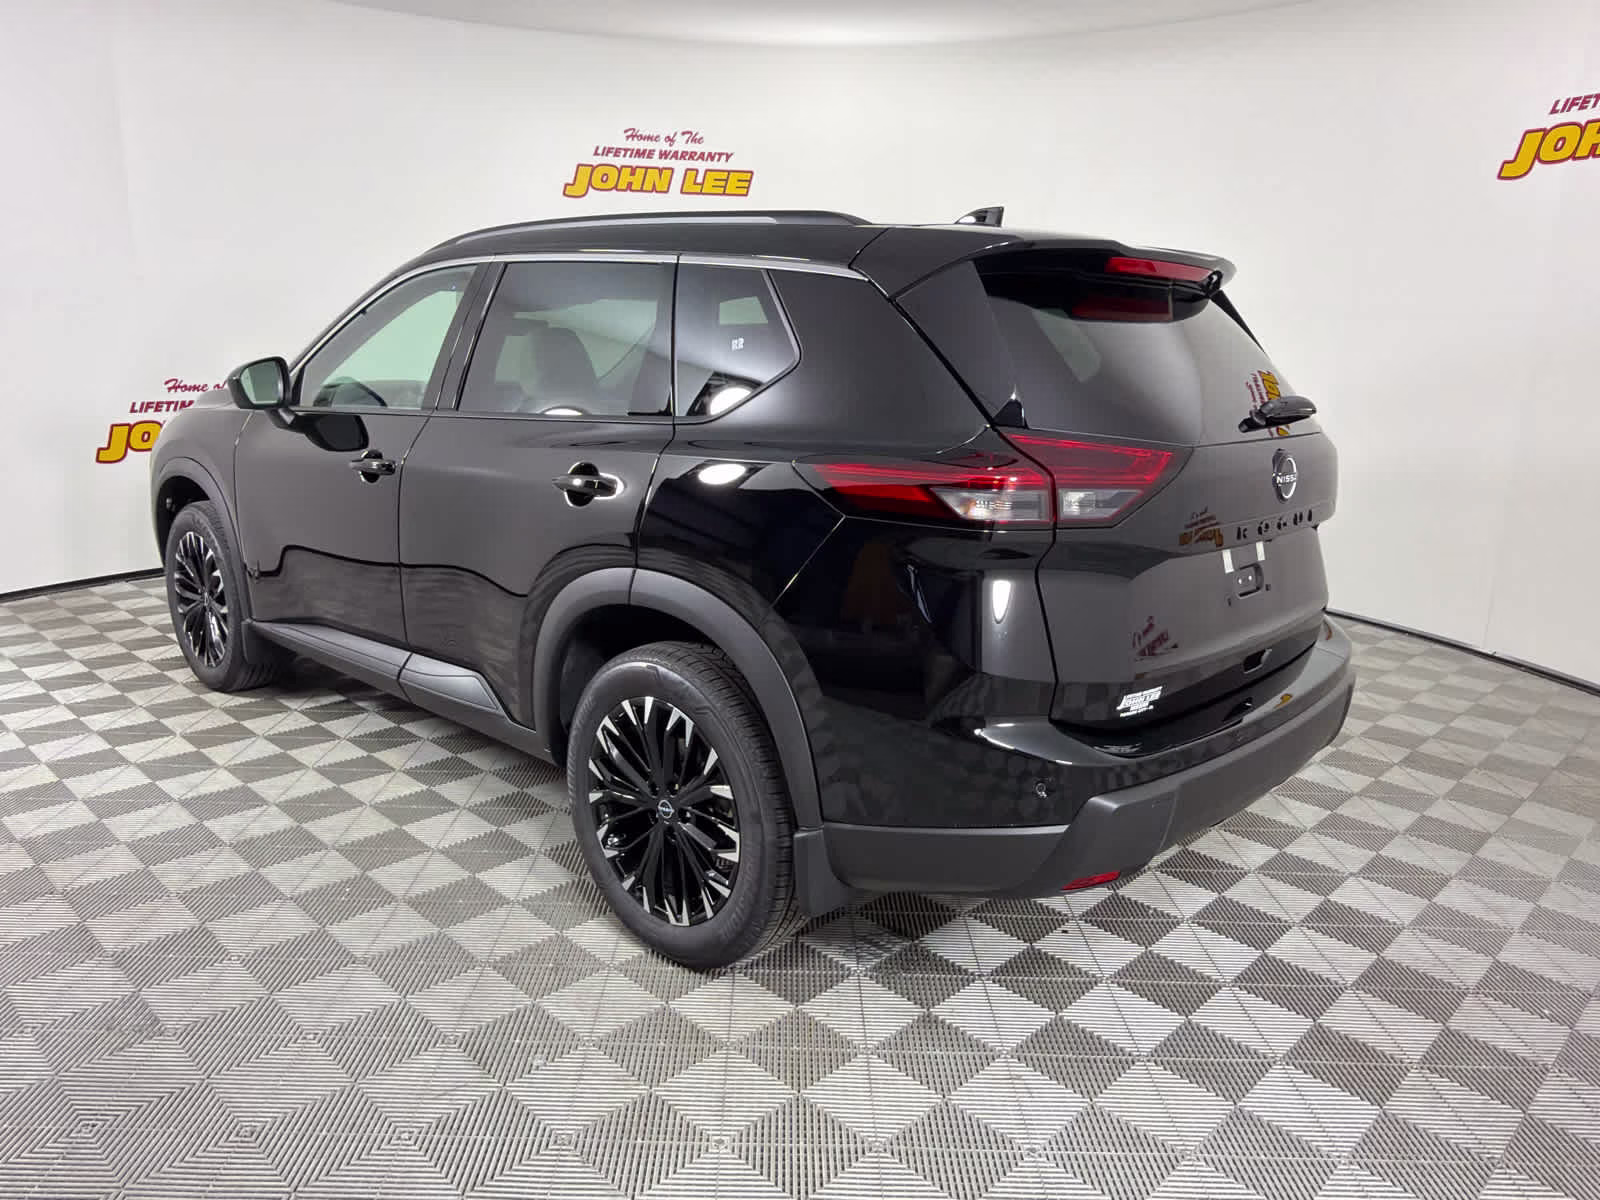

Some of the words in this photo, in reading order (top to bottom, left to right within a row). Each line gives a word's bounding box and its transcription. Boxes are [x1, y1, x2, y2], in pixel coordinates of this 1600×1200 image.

[1548, 93, 1600, 115] LIFET
[623, 127, 661, 143] Home
[664, 131, 676, 147] of
[680, 130, 704, 145] The
[593, 145, 655, 160] LIFETIME
[658, 149, 733, 163] WARRANTY
[1497, 118, 1600, 180] JO
[563, 163, 674, 198] JOHN
[680, 168, 754, 197] LEE
[164, 378, 209, 393] Home
[129, 400, 195, 414] LIFETIM
[95, 420, 163, 464] JO
